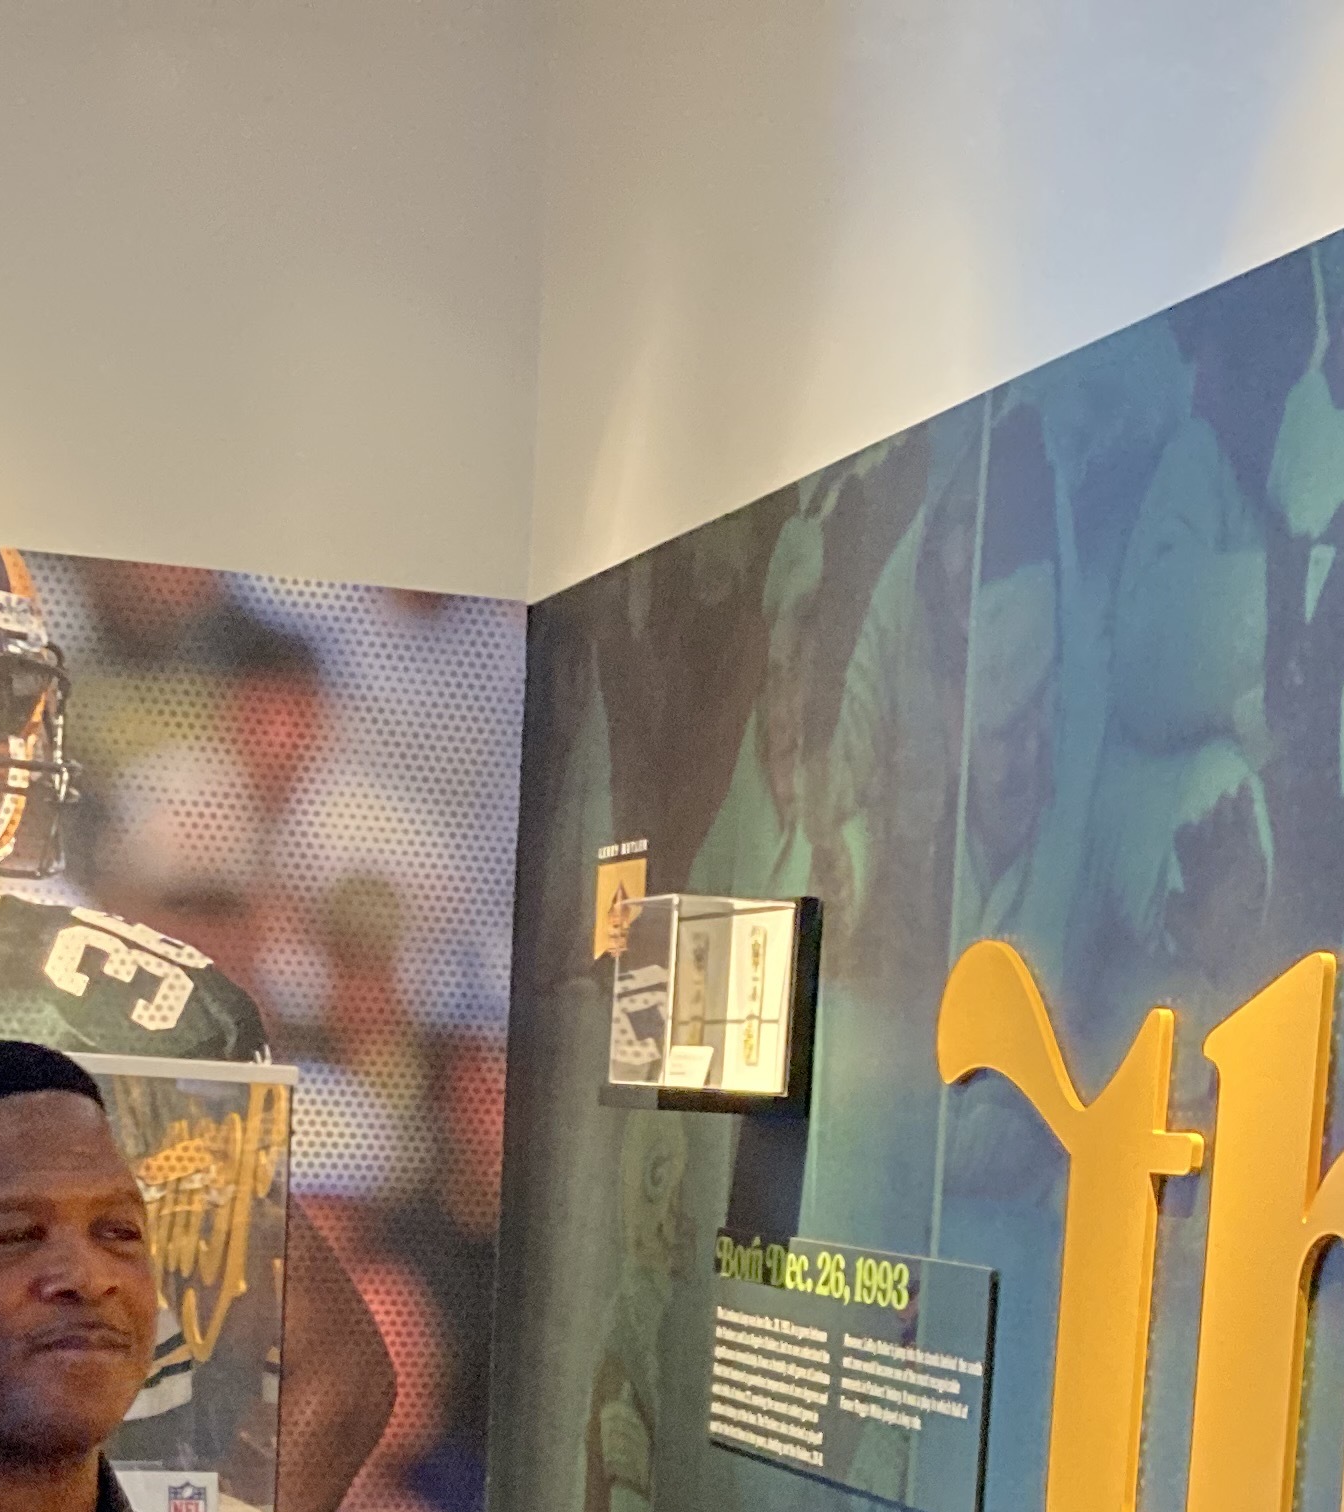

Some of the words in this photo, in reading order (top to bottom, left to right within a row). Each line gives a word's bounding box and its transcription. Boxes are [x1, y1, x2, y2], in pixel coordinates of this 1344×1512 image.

[764, 1243, 813, 1292] Dec.
[815, 1251, 850, 1305] 26,
[854, 1256, 909, 1310] 1993
